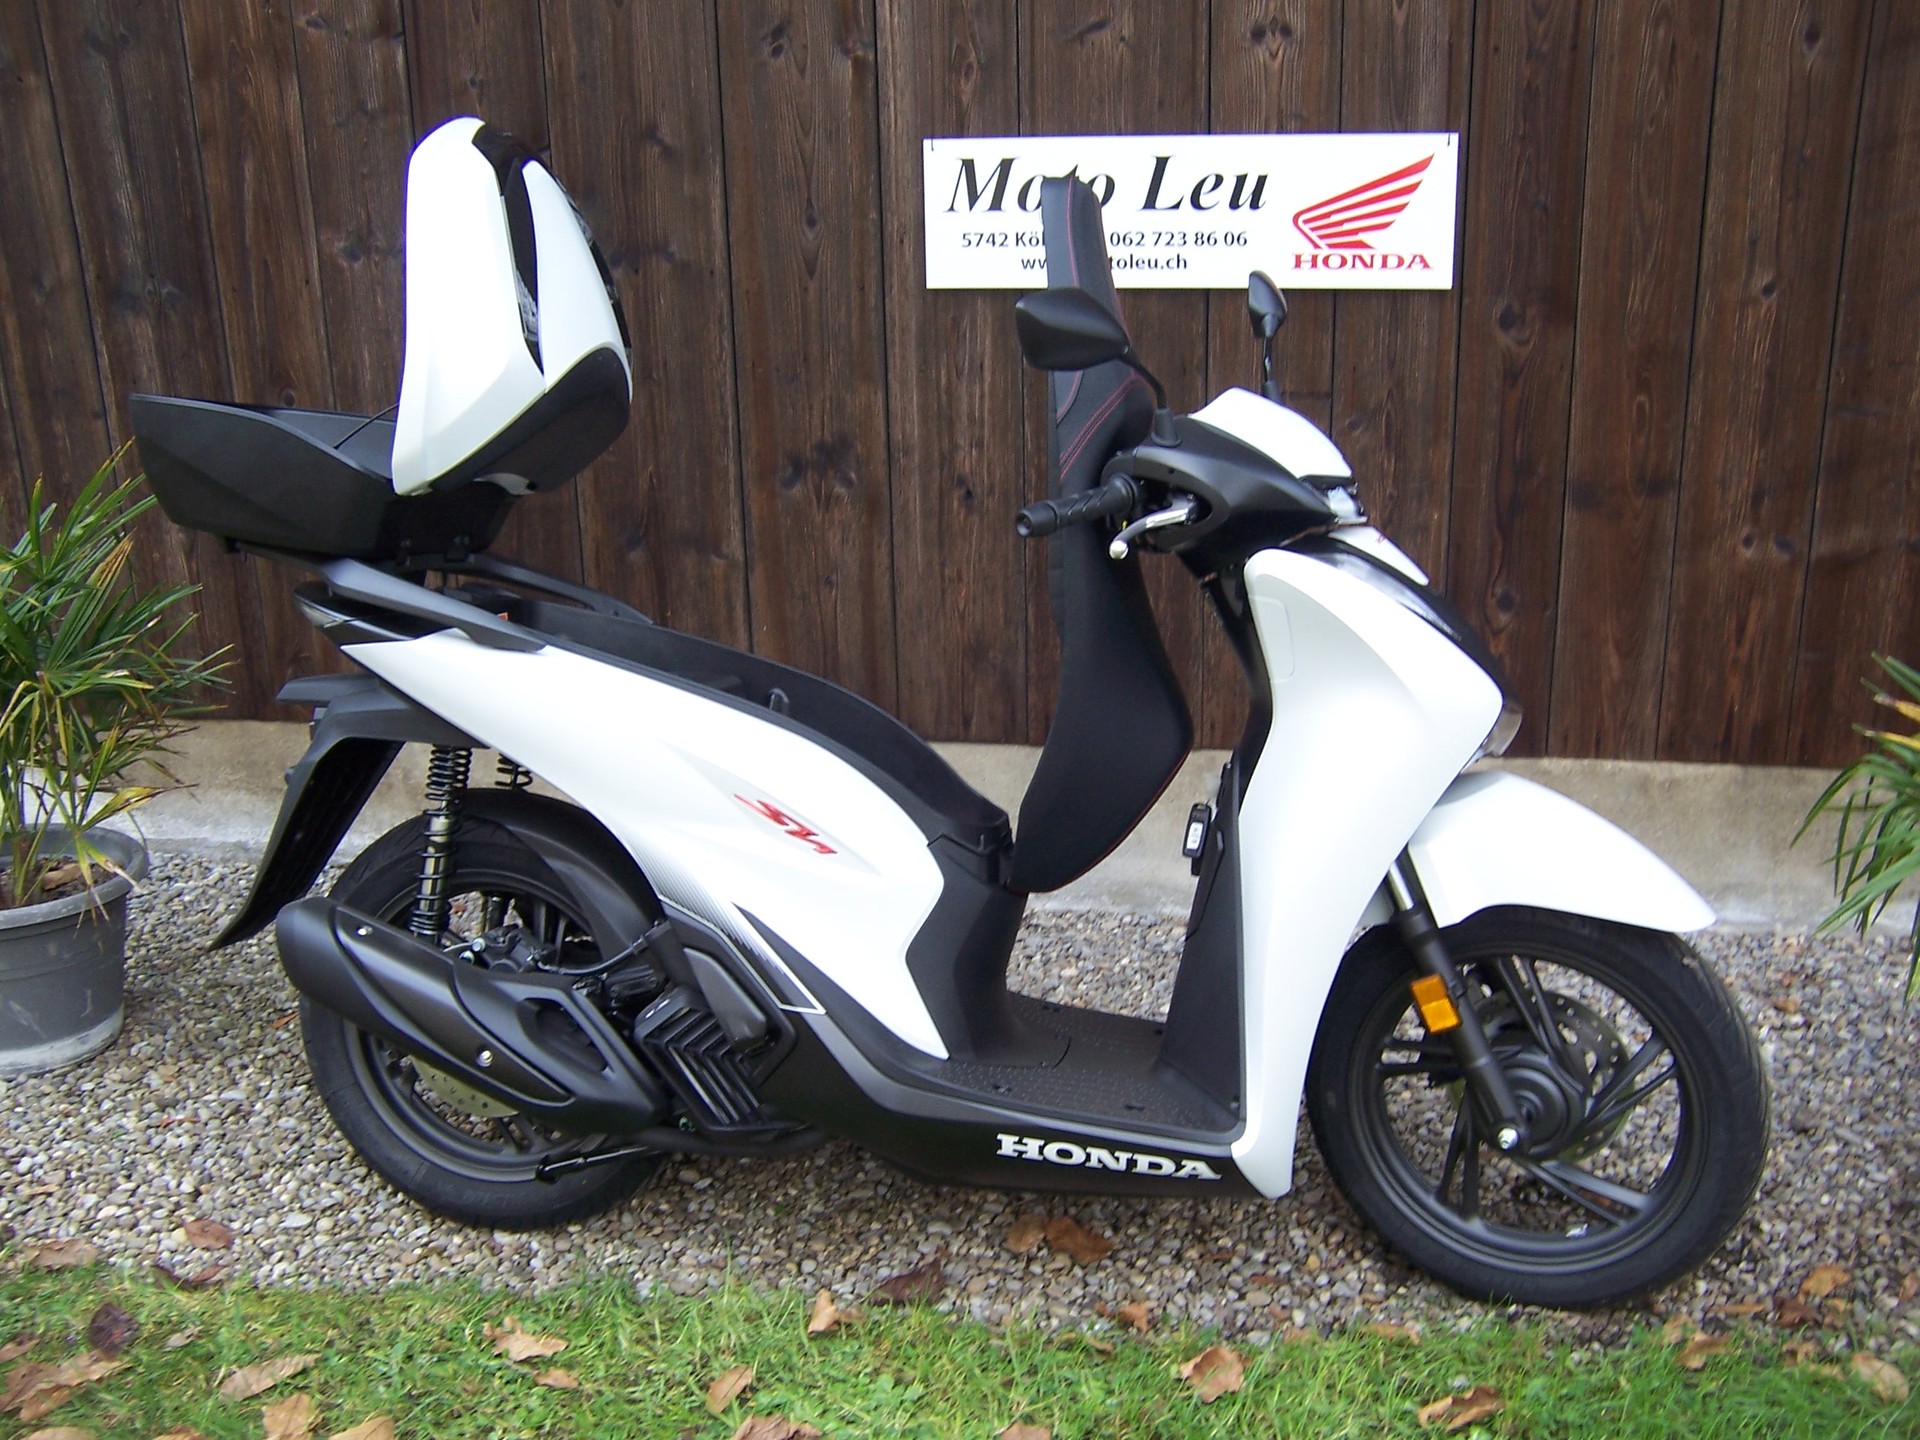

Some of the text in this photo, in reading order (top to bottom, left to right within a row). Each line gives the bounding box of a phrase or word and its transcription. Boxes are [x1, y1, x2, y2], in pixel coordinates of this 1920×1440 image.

[944, 155, 1268, 211] Moo Leu
[962, 231, 1008, 248] 5742
[1110, 231, 1145, 247] 062
[1152, 231, 1187, 247] 723
[1194, 231, 1217, 247] 86
[1224, 231, 1248, 247] 06
[1293, 252, 1433, 270] HONDA
[996, 1133, 1222, 1180] HONDA
